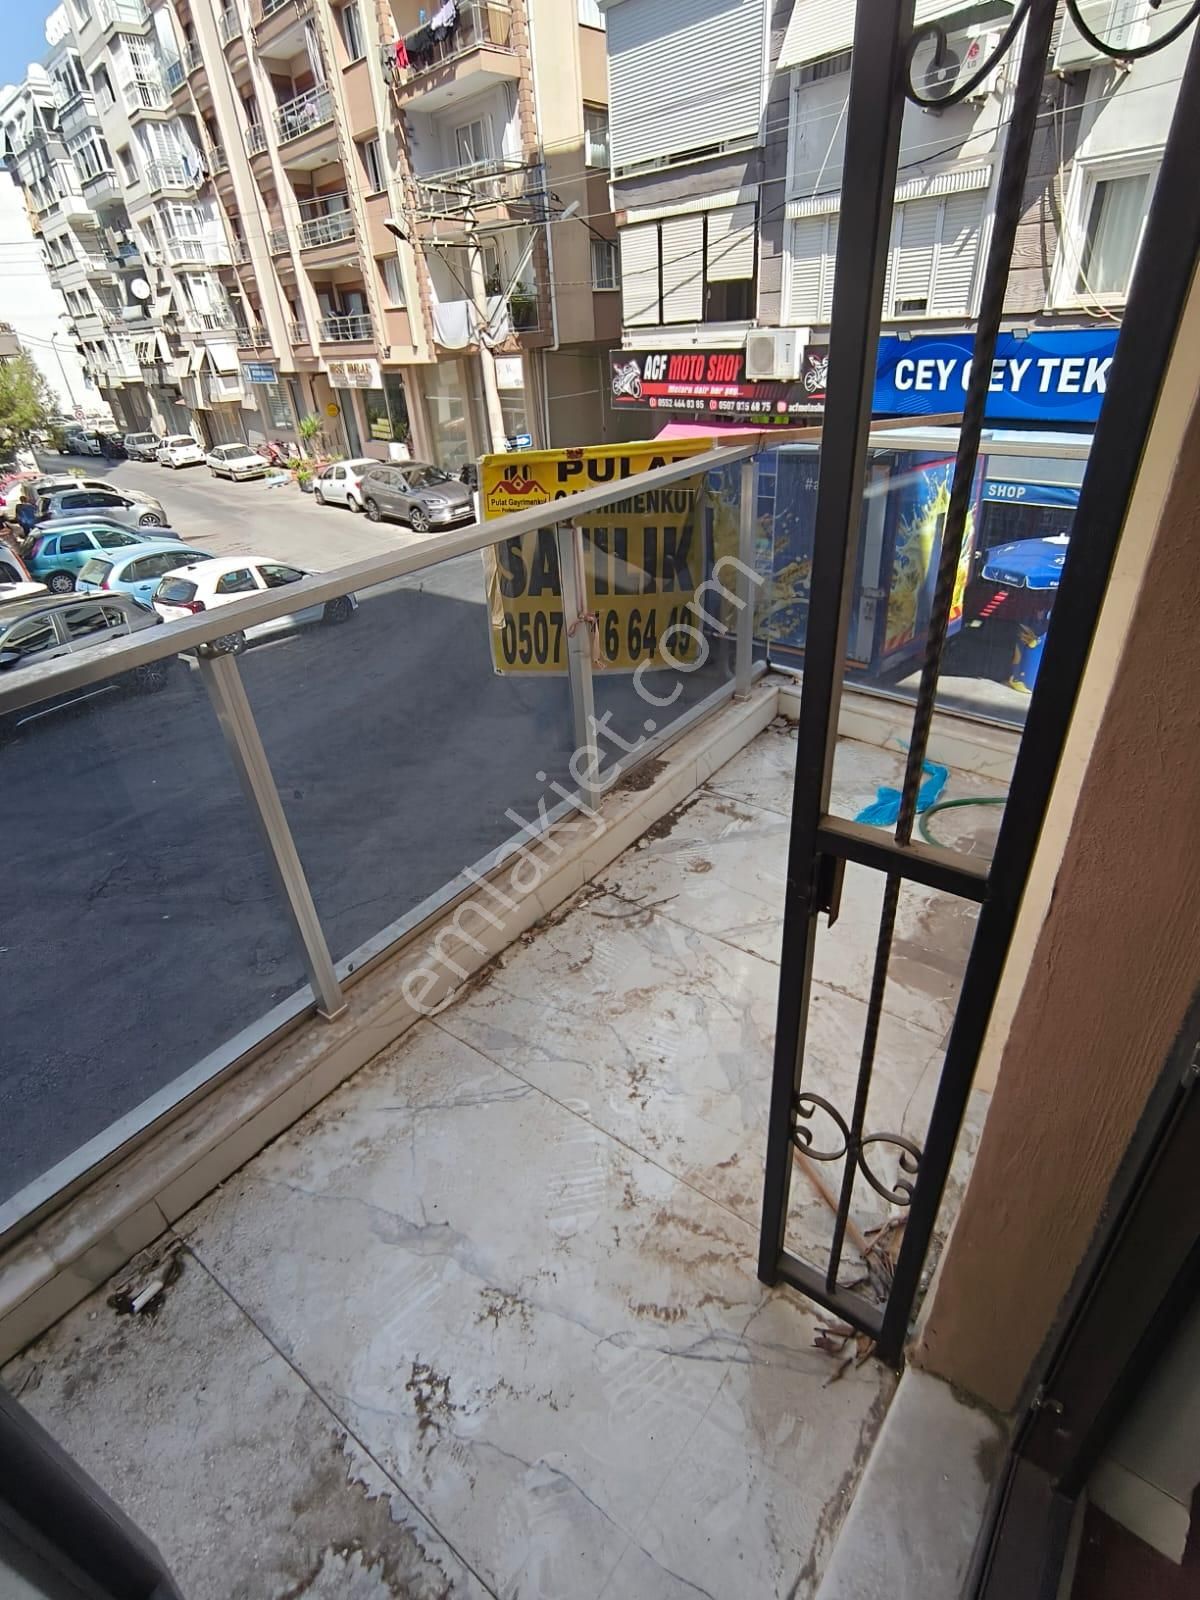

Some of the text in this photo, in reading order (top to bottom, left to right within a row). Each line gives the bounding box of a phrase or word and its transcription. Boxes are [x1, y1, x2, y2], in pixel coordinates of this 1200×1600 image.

[644, 355, 742, 382] ACF MOTO SHOP
[894, 358, 957, 391] CEY
[491, 498, 507, 506] Pulat
[988, 484, 1026, 499] SHOP
[499, 526, 695, 598] SAILIK
[502, 610, 564, 664] 0507
[627, 608, 657, 661] 64
